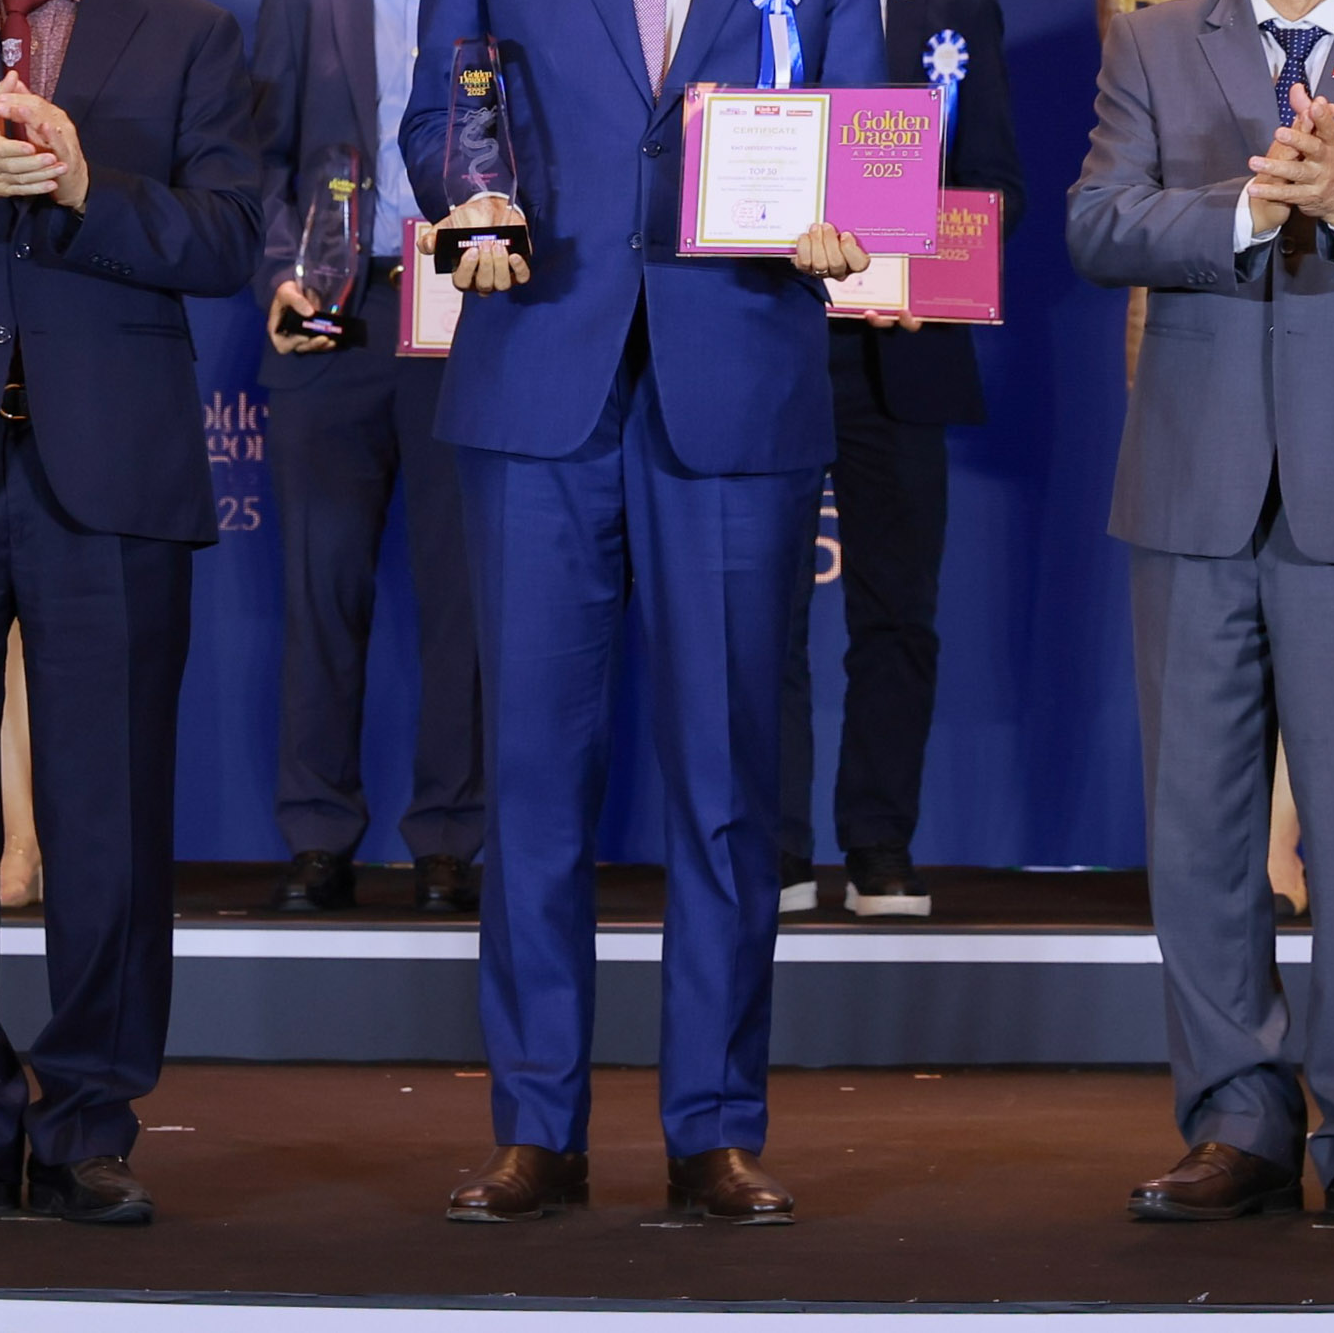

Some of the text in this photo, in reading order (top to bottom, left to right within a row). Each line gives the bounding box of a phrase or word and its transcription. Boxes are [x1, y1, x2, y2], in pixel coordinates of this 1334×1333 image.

[852, 109, 931, 131] Golden
[733, 126, 797, 135] CERTIFICATE
[838, 124, 922, 151] Dragon
[749, 167, 766, 176] TOP
[863, 162, 904, 179] 2025
